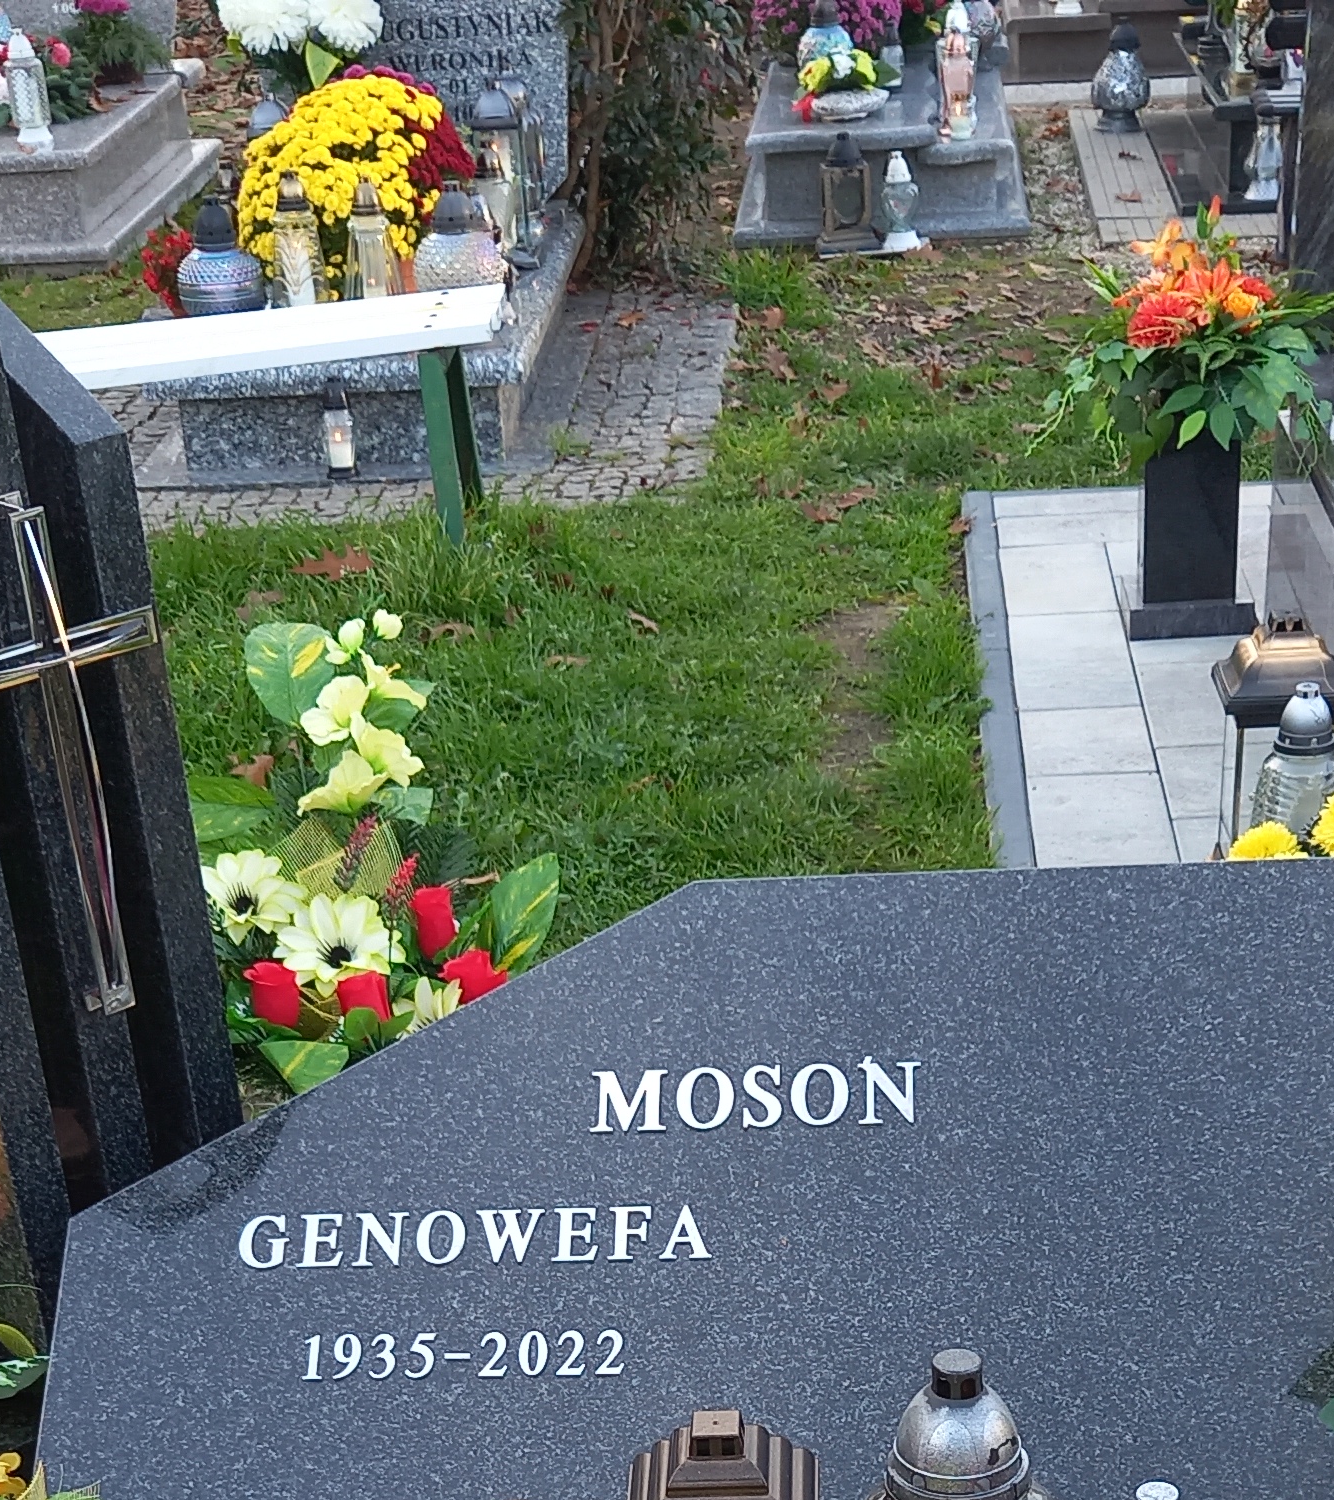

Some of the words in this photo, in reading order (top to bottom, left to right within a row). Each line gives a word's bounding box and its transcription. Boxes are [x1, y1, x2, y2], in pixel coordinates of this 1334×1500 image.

[380, 10, 553, 42] UGUSTYNIAK
[590, 1056, 921, 1132] MOSON
[239, 1205, 712, 1268] GENOWEFA
[302, 1330, 624, 1379] 1935-2022
